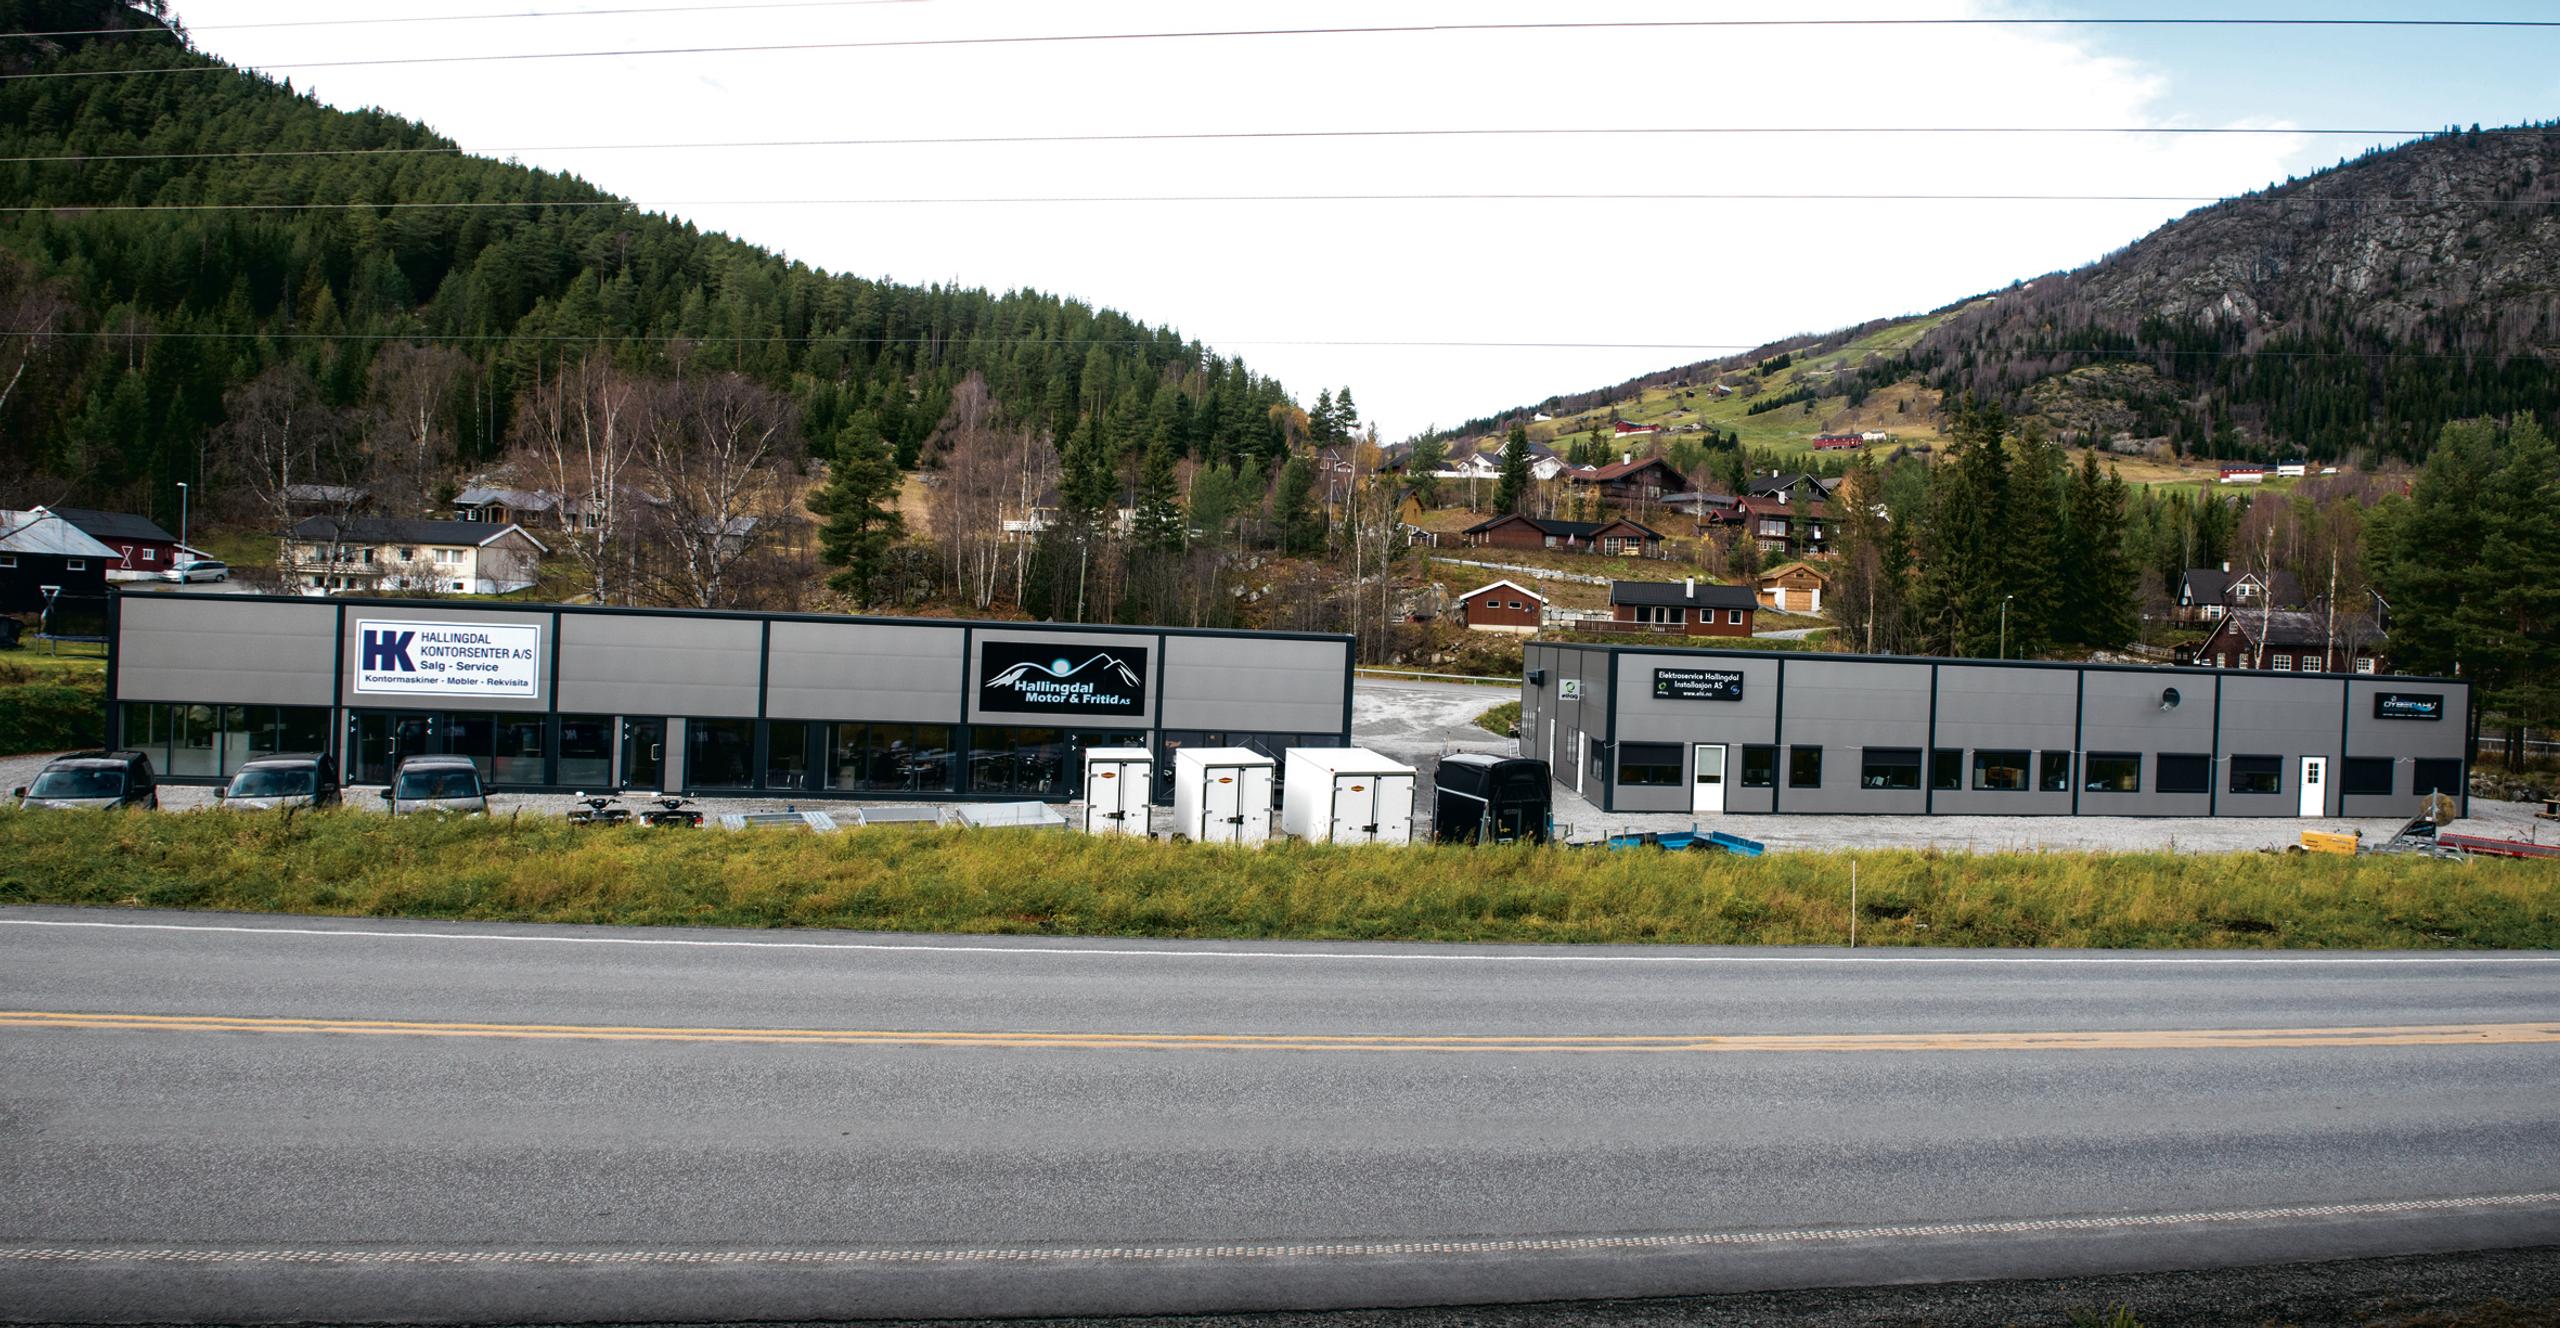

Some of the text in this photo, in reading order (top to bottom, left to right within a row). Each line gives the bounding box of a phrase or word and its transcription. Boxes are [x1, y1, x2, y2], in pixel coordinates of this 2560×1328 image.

[421, 632, 491, 644] HALLINGDAL
[362, 630, 416, 672] HK
[421, 646, 532, 659] KONTORSENTER A/S
[420, 661, 445, 672] Salg
[457, 662, 499, 672] Service
[365, 675, 438, 684] Kontormaskiner
[447, 677, 478, 685] Møbler
[487, 678, 529, 686] Rekvisita
[1705, 674, 1739, 682] Hallingdal
[1015, 680, 1094, 695] Hallingdal
[1674, 681, 1712, 690] Installasjon
[1026, 693, 1065, 702] Motor
[1069, 694, 1079, 703] &
[1082, 694, 1118, 704] Fritid
